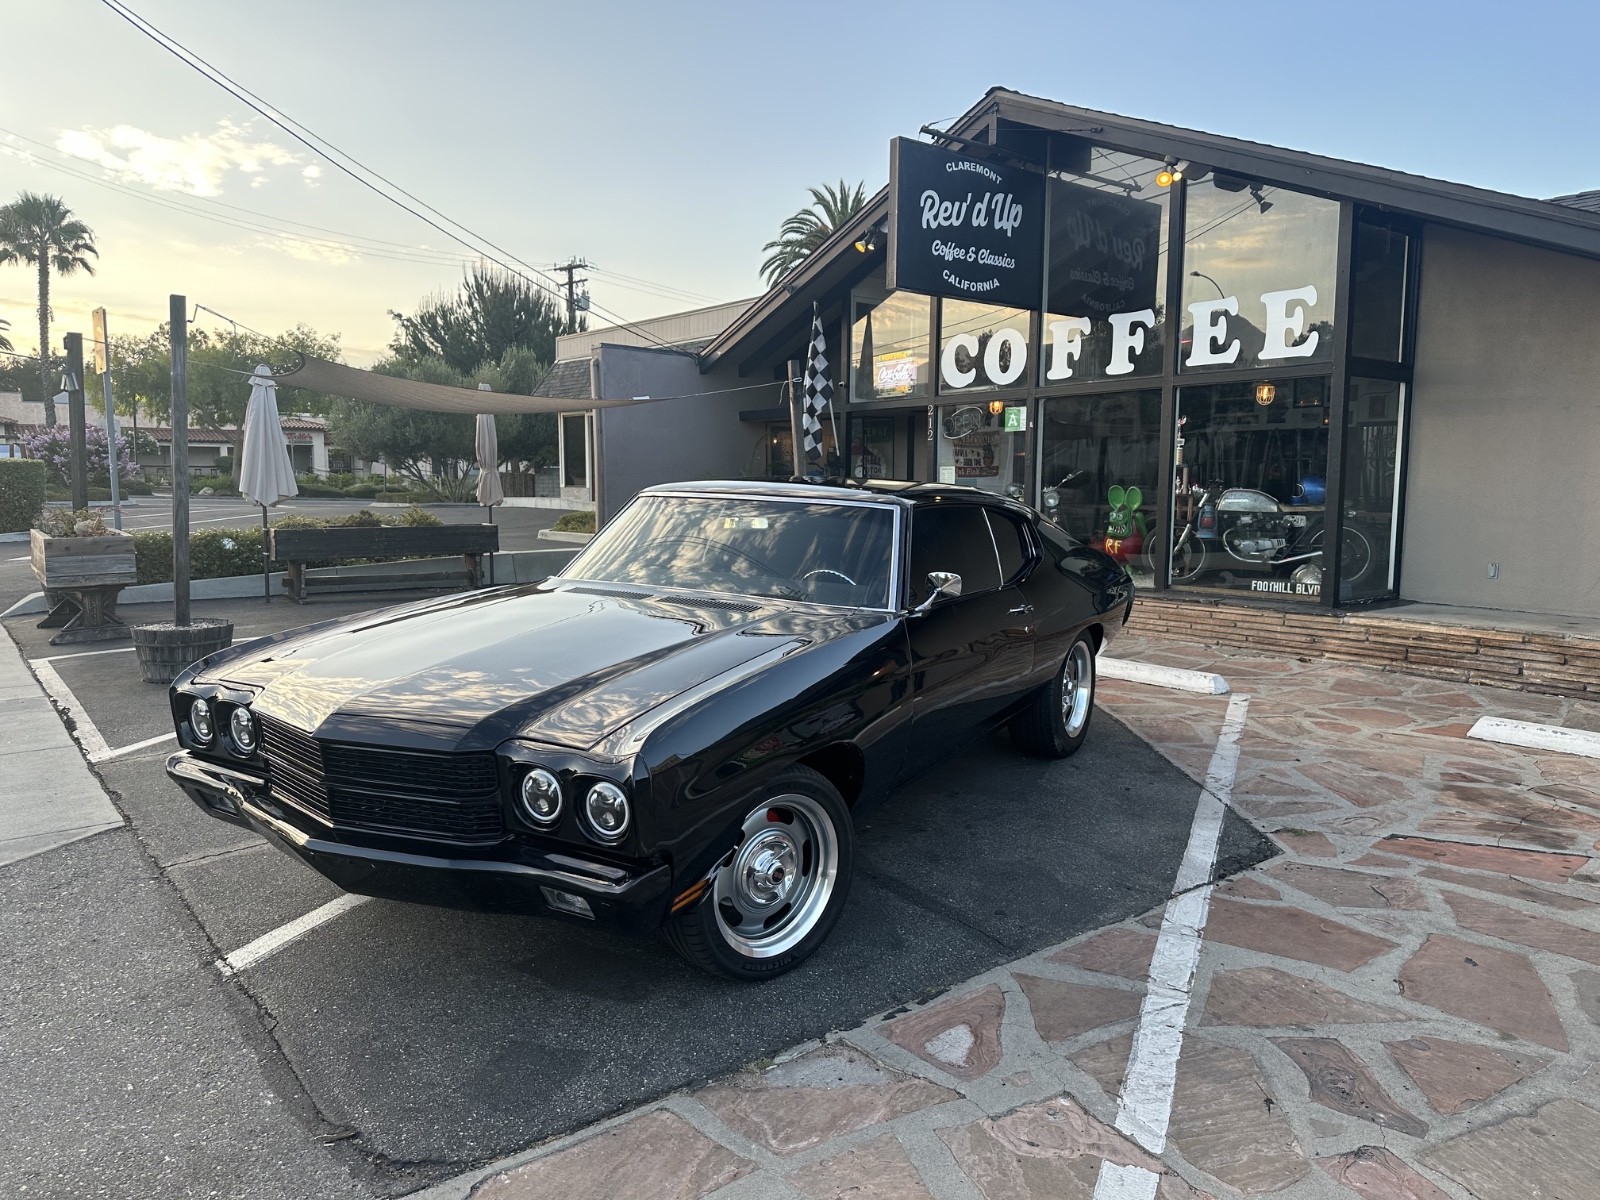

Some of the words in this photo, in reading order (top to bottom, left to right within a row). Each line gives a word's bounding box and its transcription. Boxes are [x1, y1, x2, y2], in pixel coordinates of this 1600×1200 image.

[945, 161, 1002, 185] CLAREMONT
[920, 189, 989, 229] Rev'd
[991, 192, 1023, 237] Up
[931, 239, 966, 262] Coffee
[966, 246, 977, 262] &
[977, 249, 1016, 269] Classics
[942, 269, 1000, 292] CALIFORNIA
[940, 284, 1319, 388] COFFEE
[1007, 413, 1018, 427] A
[1105, 538, 1123, 554] RF
[1251, 580, 1294, 594] FOOTHILL
[1295, 583, 1321, 596] BLVD
